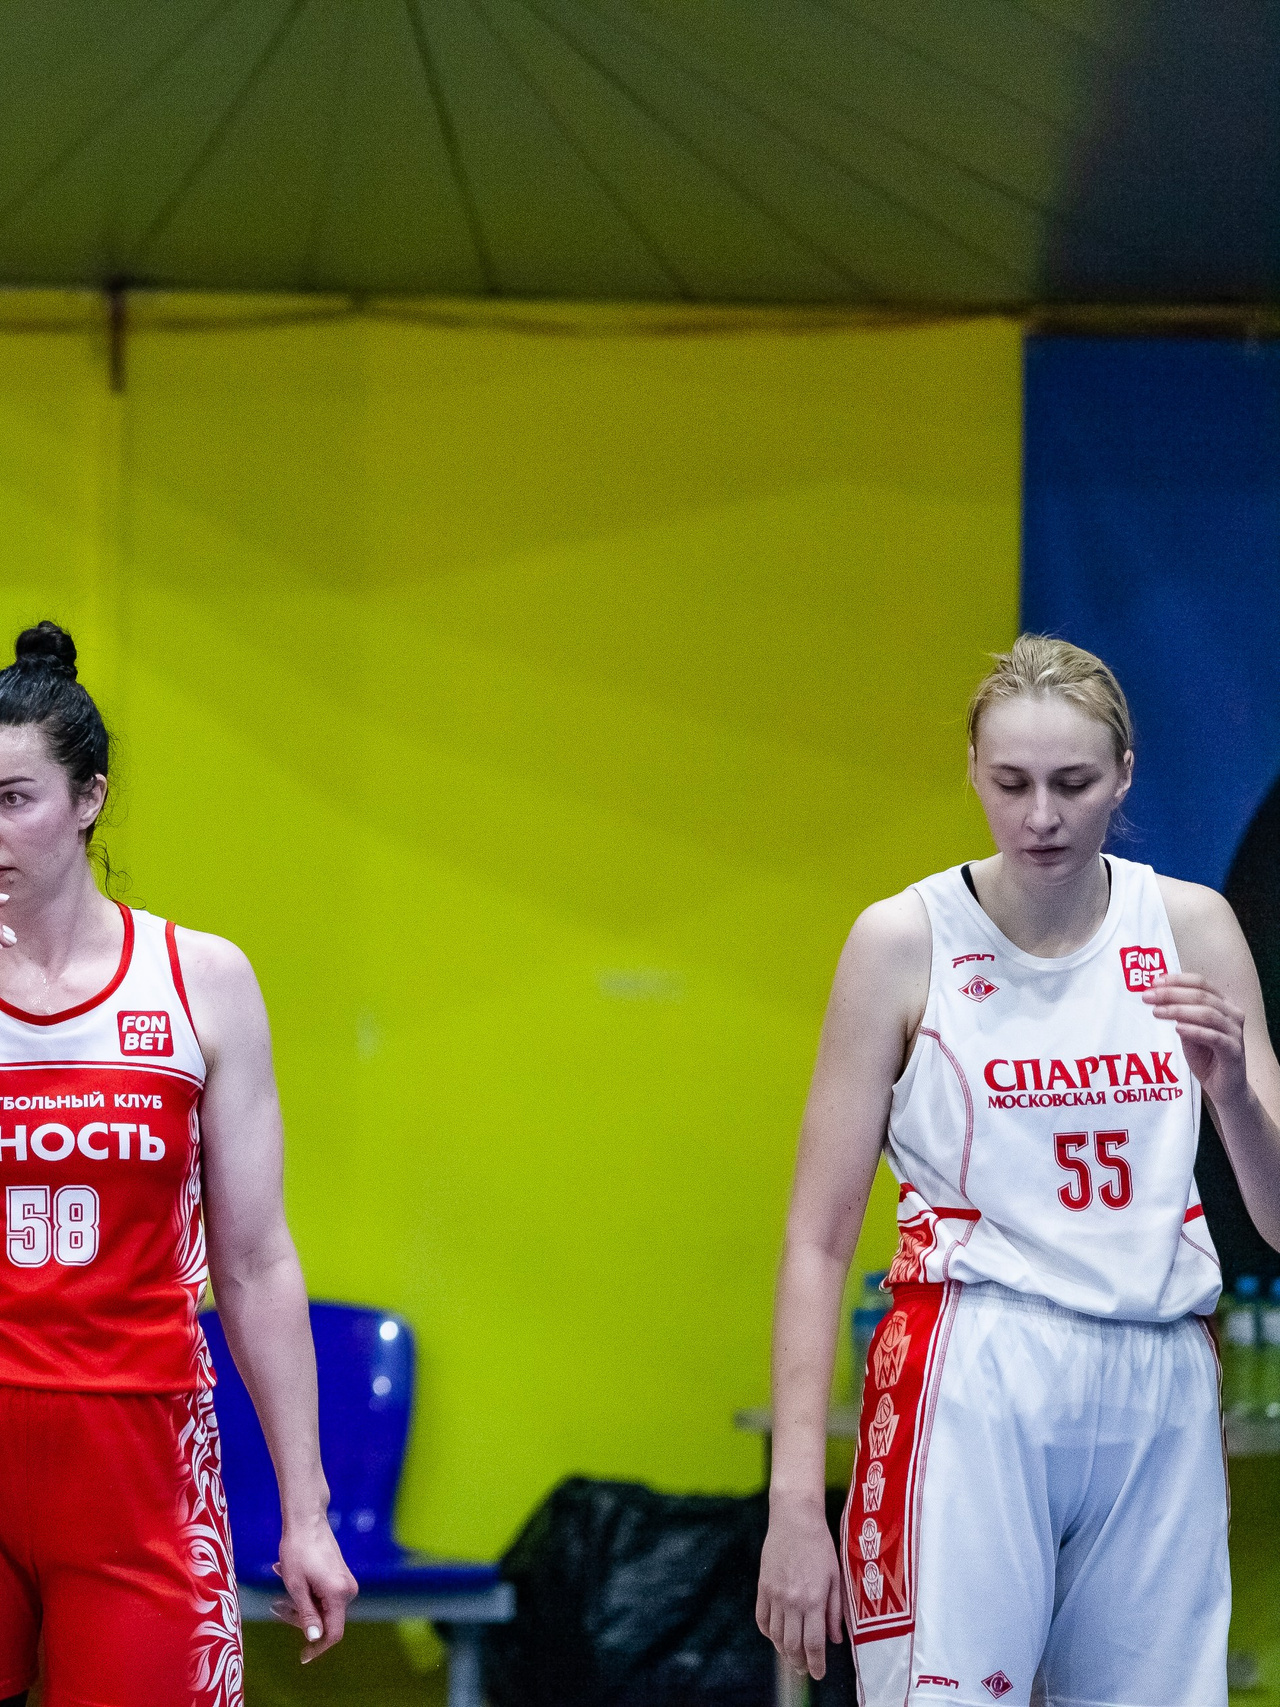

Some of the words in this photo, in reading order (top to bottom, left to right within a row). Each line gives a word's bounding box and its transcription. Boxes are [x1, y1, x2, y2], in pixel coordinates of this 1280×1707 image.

[1125, 951, 1160, 970] FON
[1129, 968, 1165, 987] BET
[121, 1015, 166, 1032] FON
[123, 1032, 169, 1051] BET
[983, 1051, 1179, 1092] СПАРТАК
[113, 1093, 163, 1110] КЛУБ
[988, 1091, 1107, 1109] МОСКОВСКАЯ
[1113, 1086, 1183, 1104] ОБЛАСТЬ
[1053, 1129, 1133, 1212] 55
[6, 1185, 99, 1268] 58
